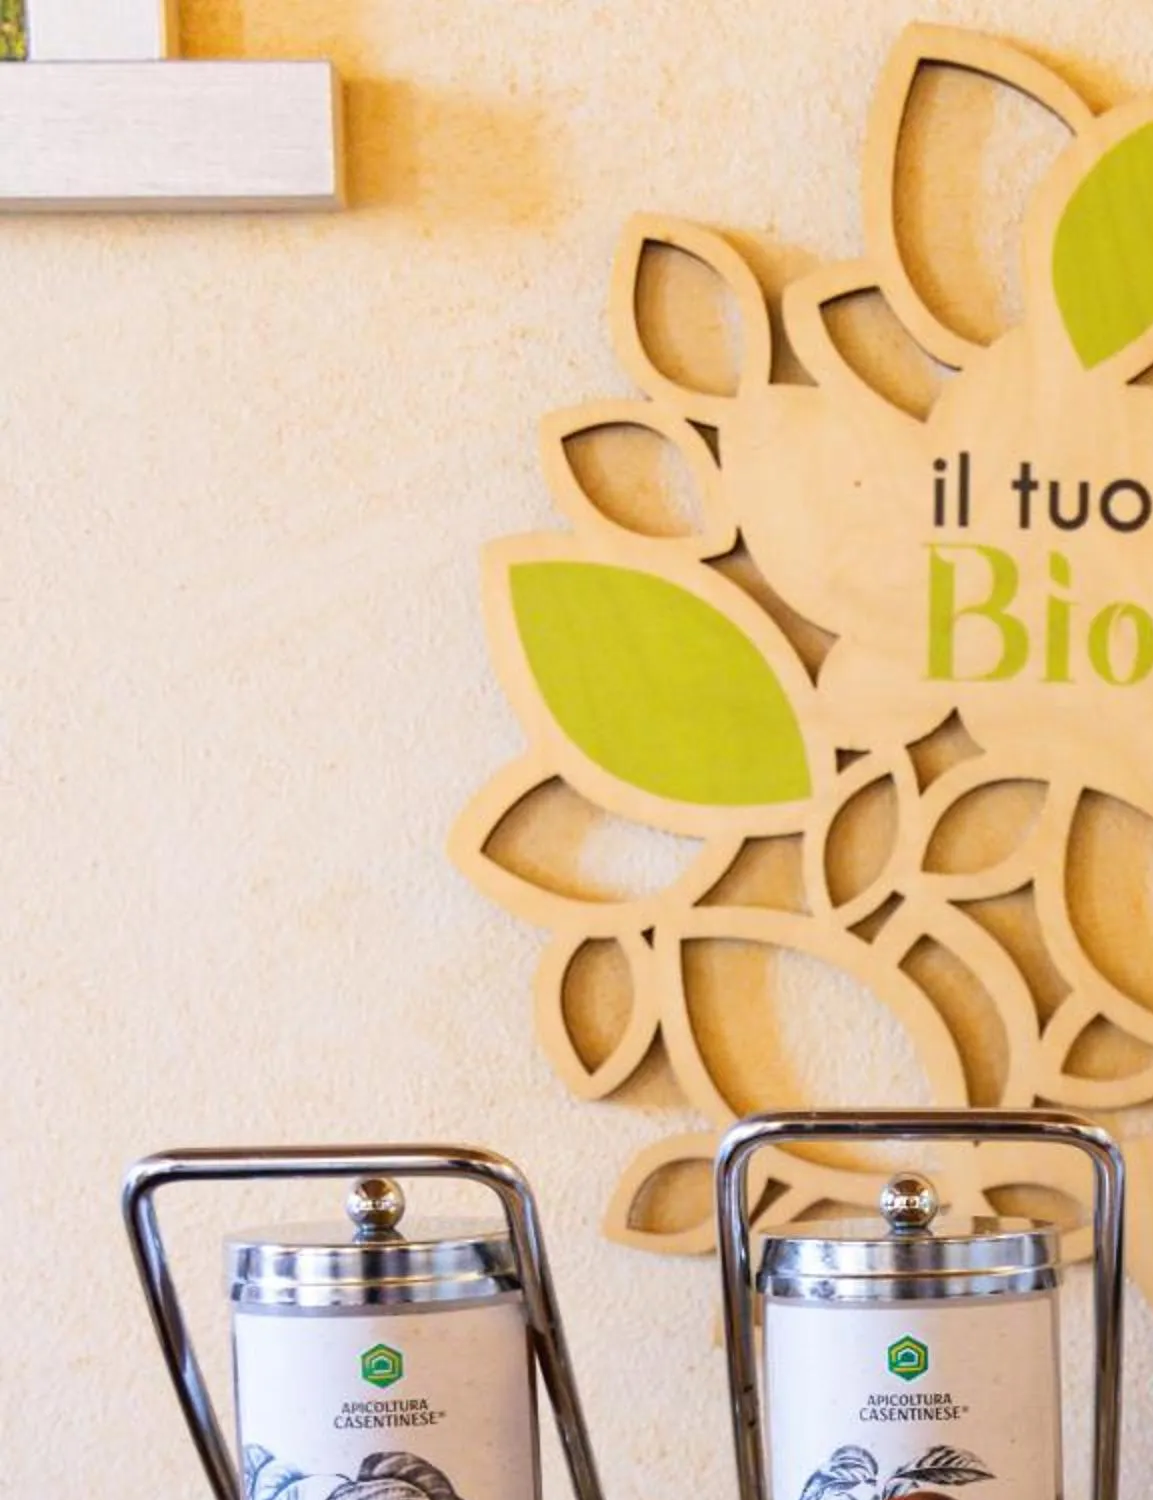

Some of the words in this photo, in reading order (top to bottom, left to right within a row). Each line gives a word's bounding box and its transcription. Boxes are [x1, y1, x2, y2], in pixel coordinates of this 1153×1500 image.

[932, 451, 970, 528] il
[1011, 461, 1153, 533] tuo
[341, 1399, 429, 1414] APICOLTURA
[867, 1393, 953, 1407] APICOLTURA
